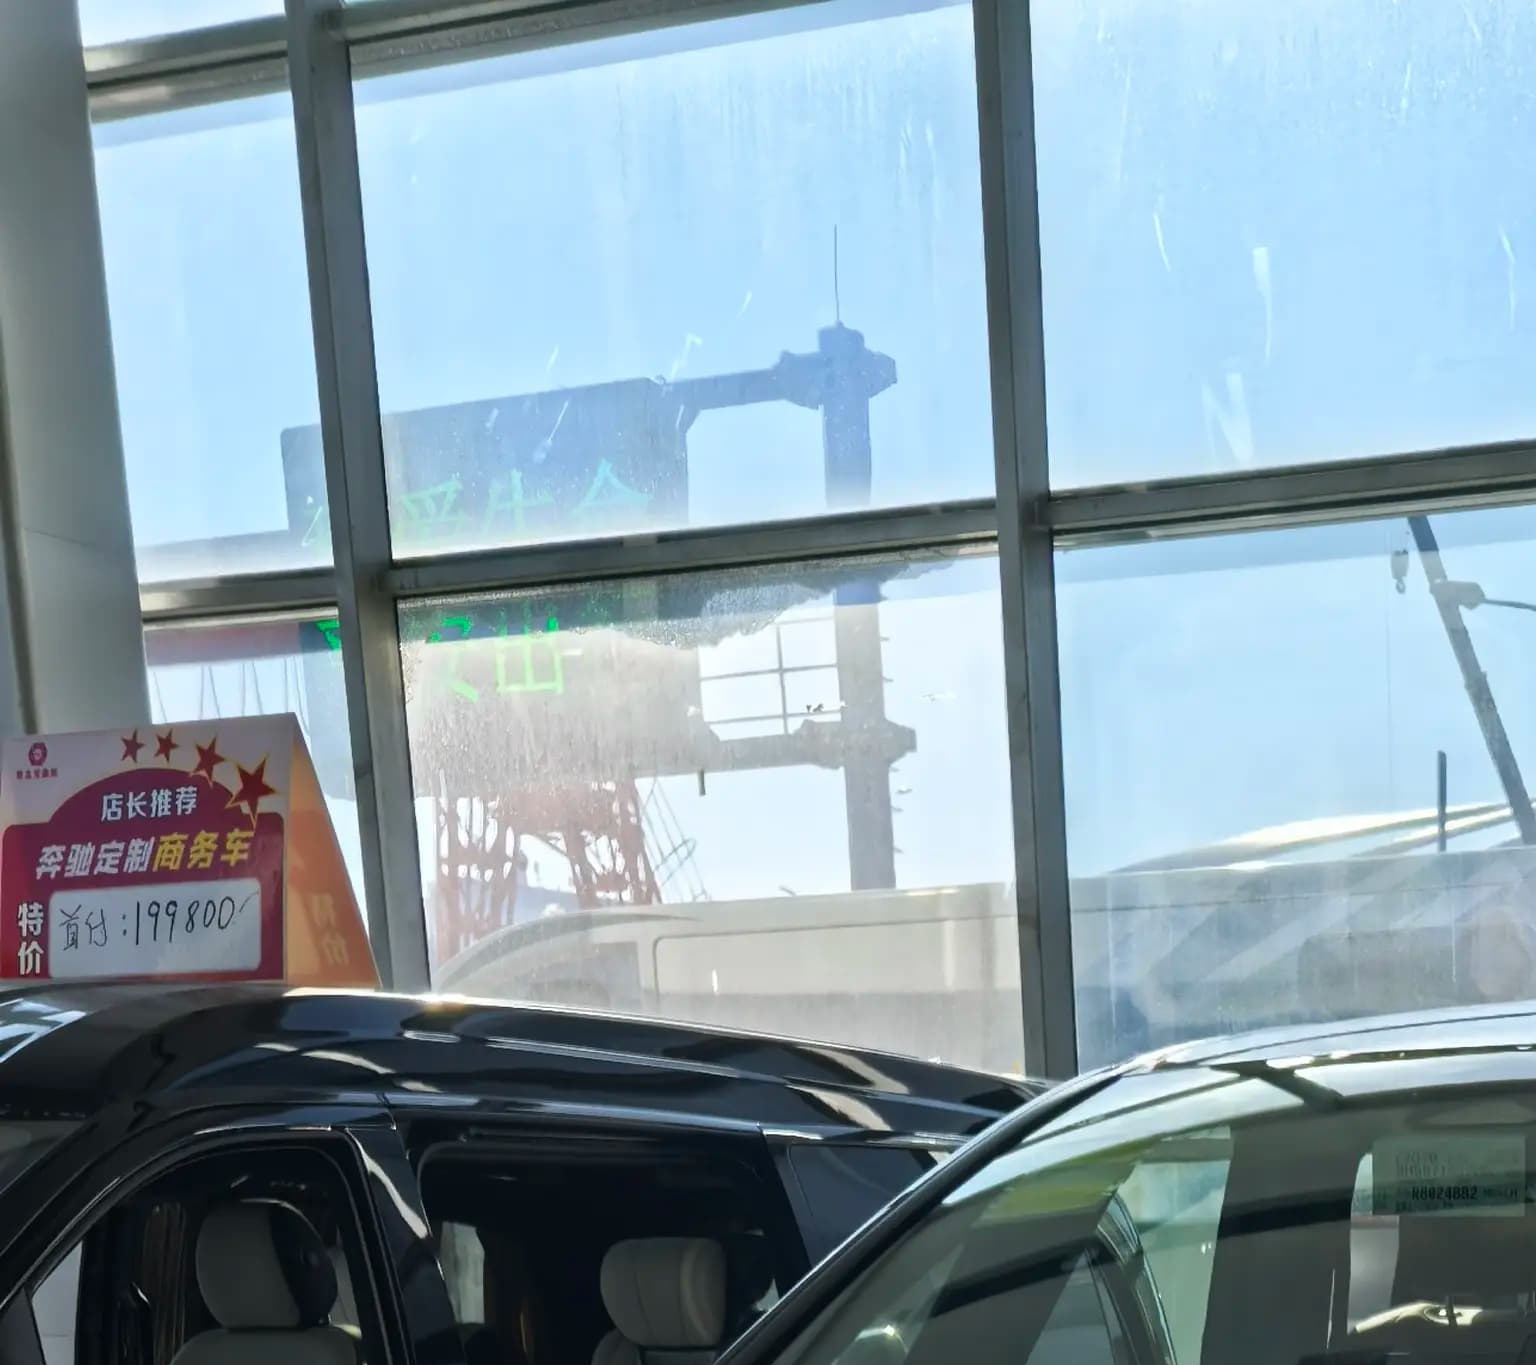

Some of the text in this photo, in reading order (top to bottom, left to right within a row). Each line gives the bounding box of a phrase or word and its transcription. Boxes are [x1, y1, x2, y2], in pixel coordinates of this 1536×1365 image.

[101, 786, 198, 822] 店长推荐
[35, 829, 255, 880] 奔驰定制商务车
[17, 901, 45, 976] 特价
